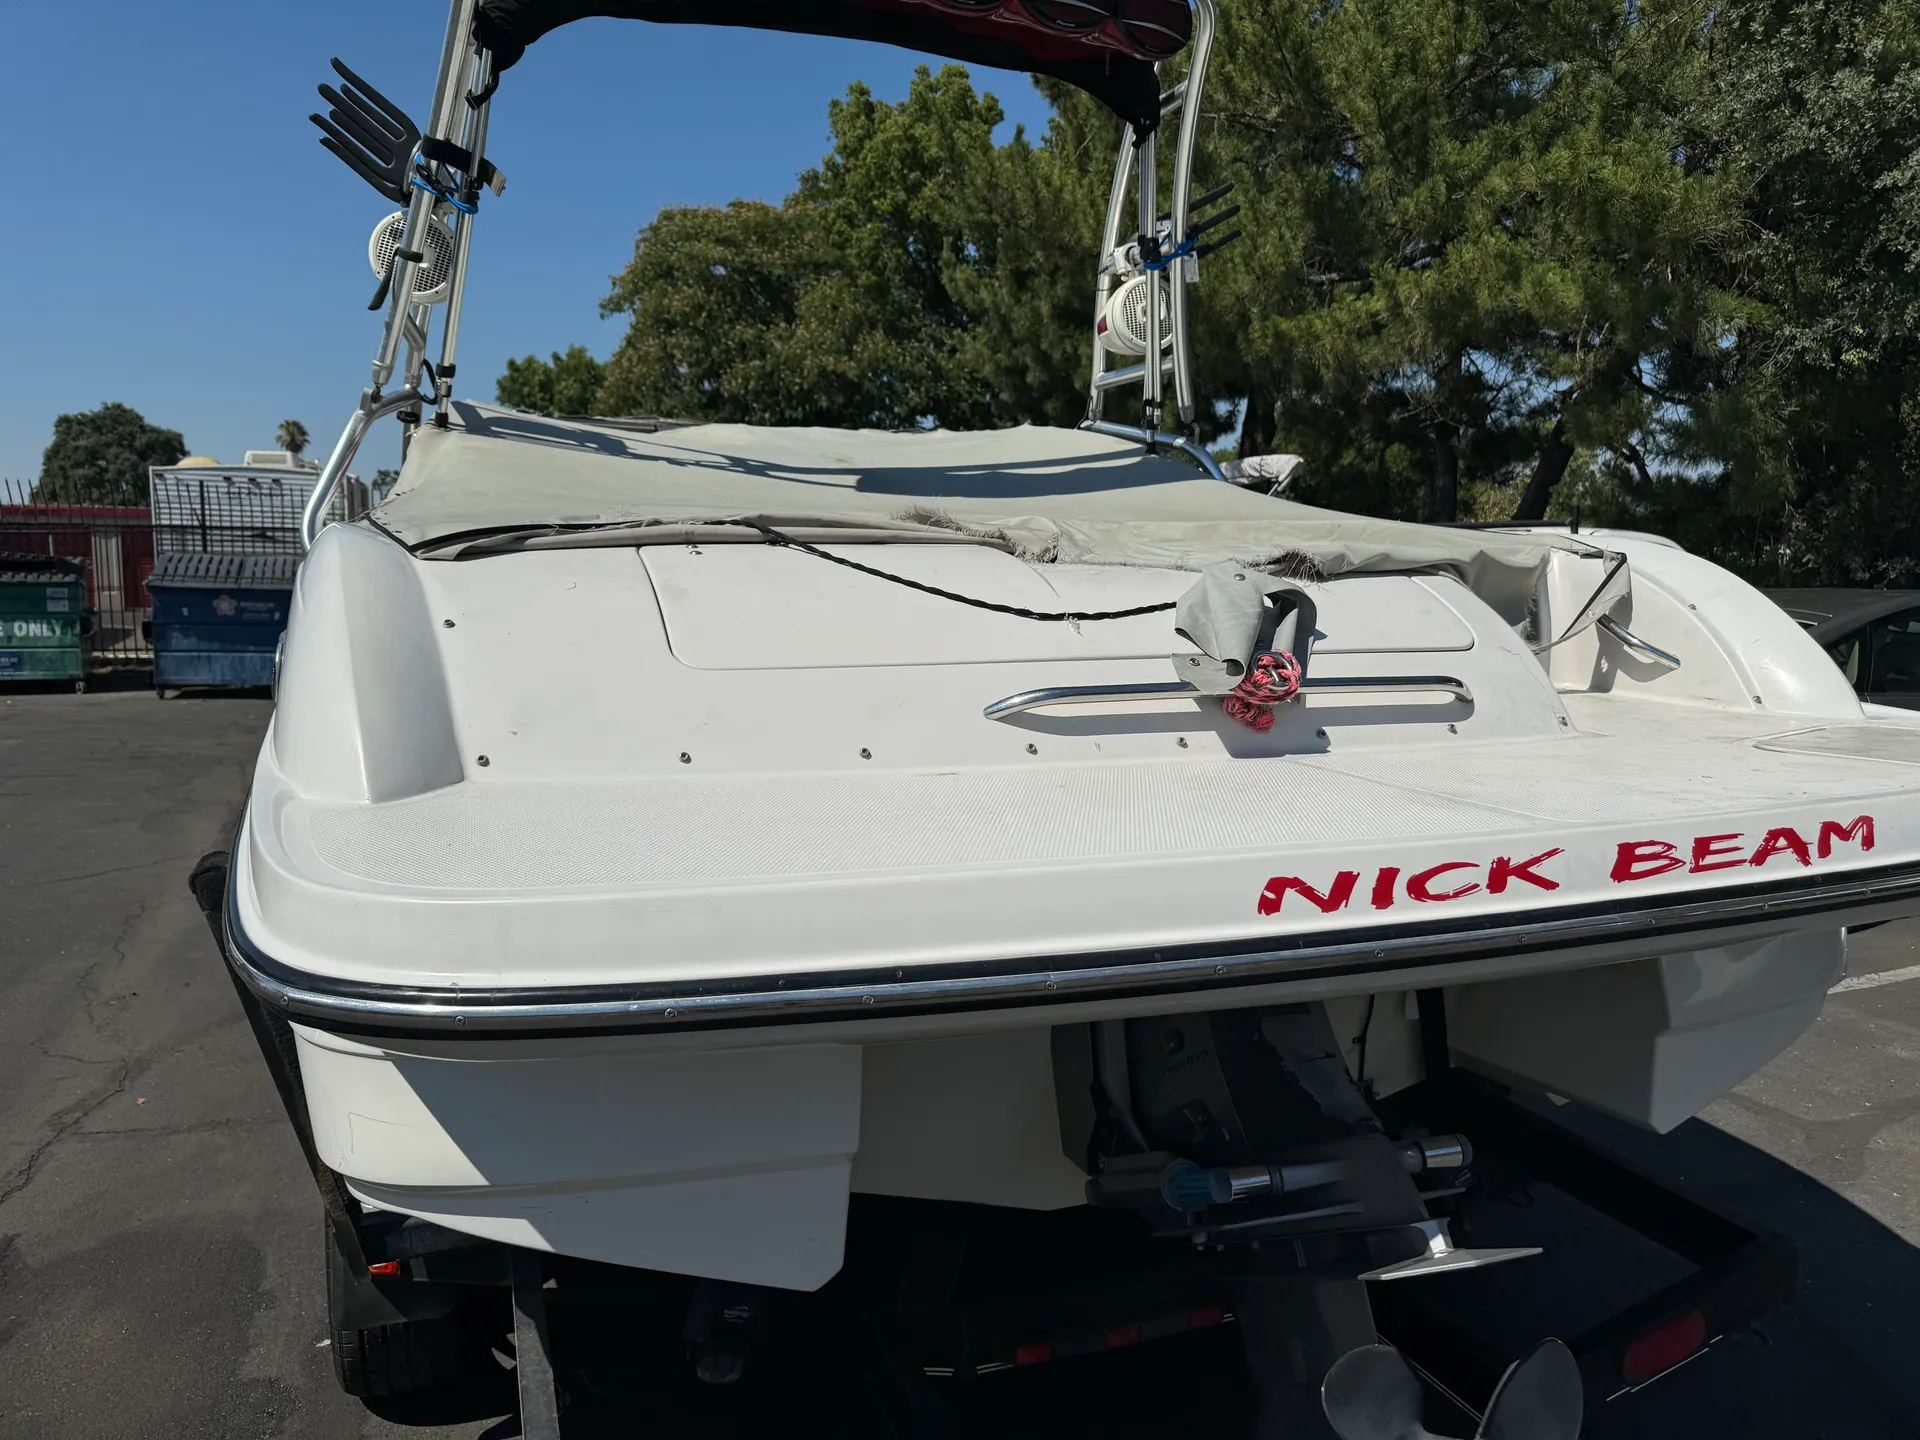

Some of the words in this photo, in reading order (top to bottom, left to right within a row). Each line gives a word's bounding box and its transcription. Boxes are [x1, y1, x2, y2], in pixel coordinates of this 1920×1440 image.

[13, 619, 63, 637] ONLY
[1258, 848, 1564, 916] NICK
[1610, 816, 1875, 883] BEAM
